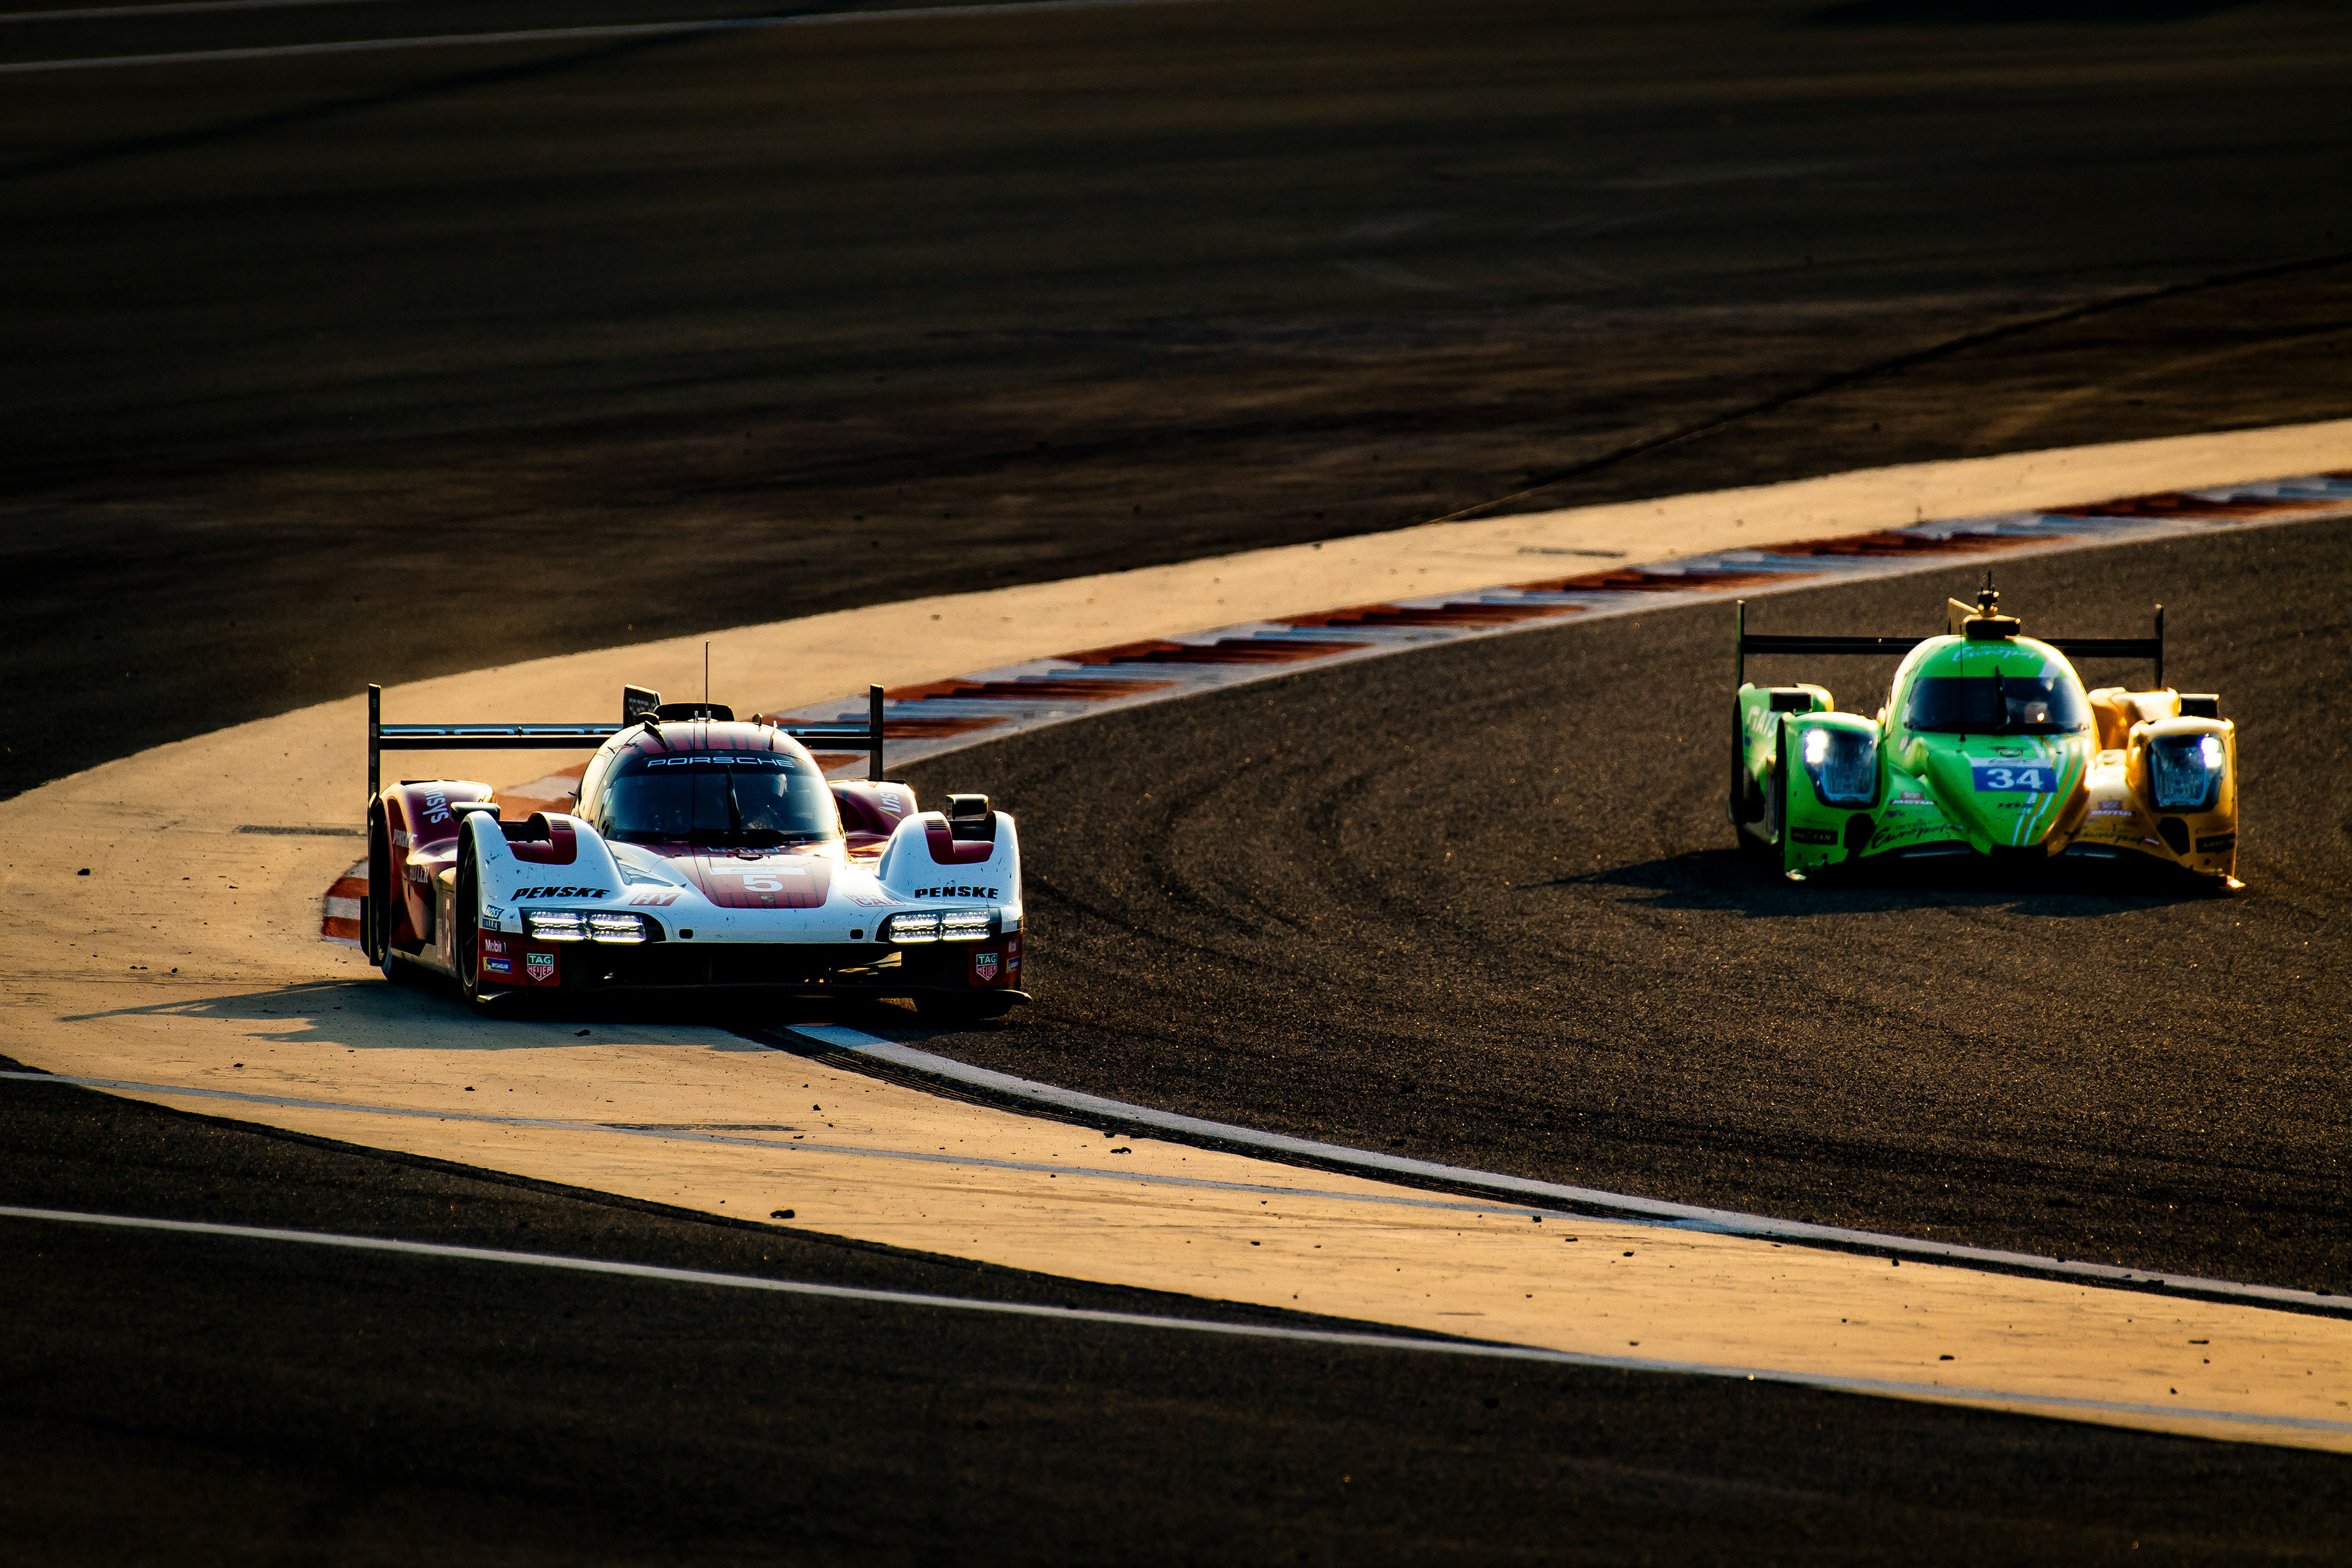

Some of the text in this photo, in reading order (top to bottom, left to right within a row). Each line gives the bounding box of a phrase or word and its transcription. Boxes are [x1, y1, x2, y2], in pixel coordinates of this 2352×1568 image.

[647, 756, 795, 767] PORSCHE
[1987, 767, 2045, 790] 34
[423, 788, 450, 823] nsys
[742, 874, 783, 892] 5
[510, 886, 611, 901] PENSKE
[633, 893, 676, 905] HY
[914, 886, 999, 899] PENSKE
[485, 906, 502, 918] BOSS
[485, 938, 507, 952] Mobil 1
[529, 956, 551, 964] TAG
[978, 956, 997, 964] TAG
[528, 966, 551, 979] HEUER
[978, 965, 997, 978] HEUER
